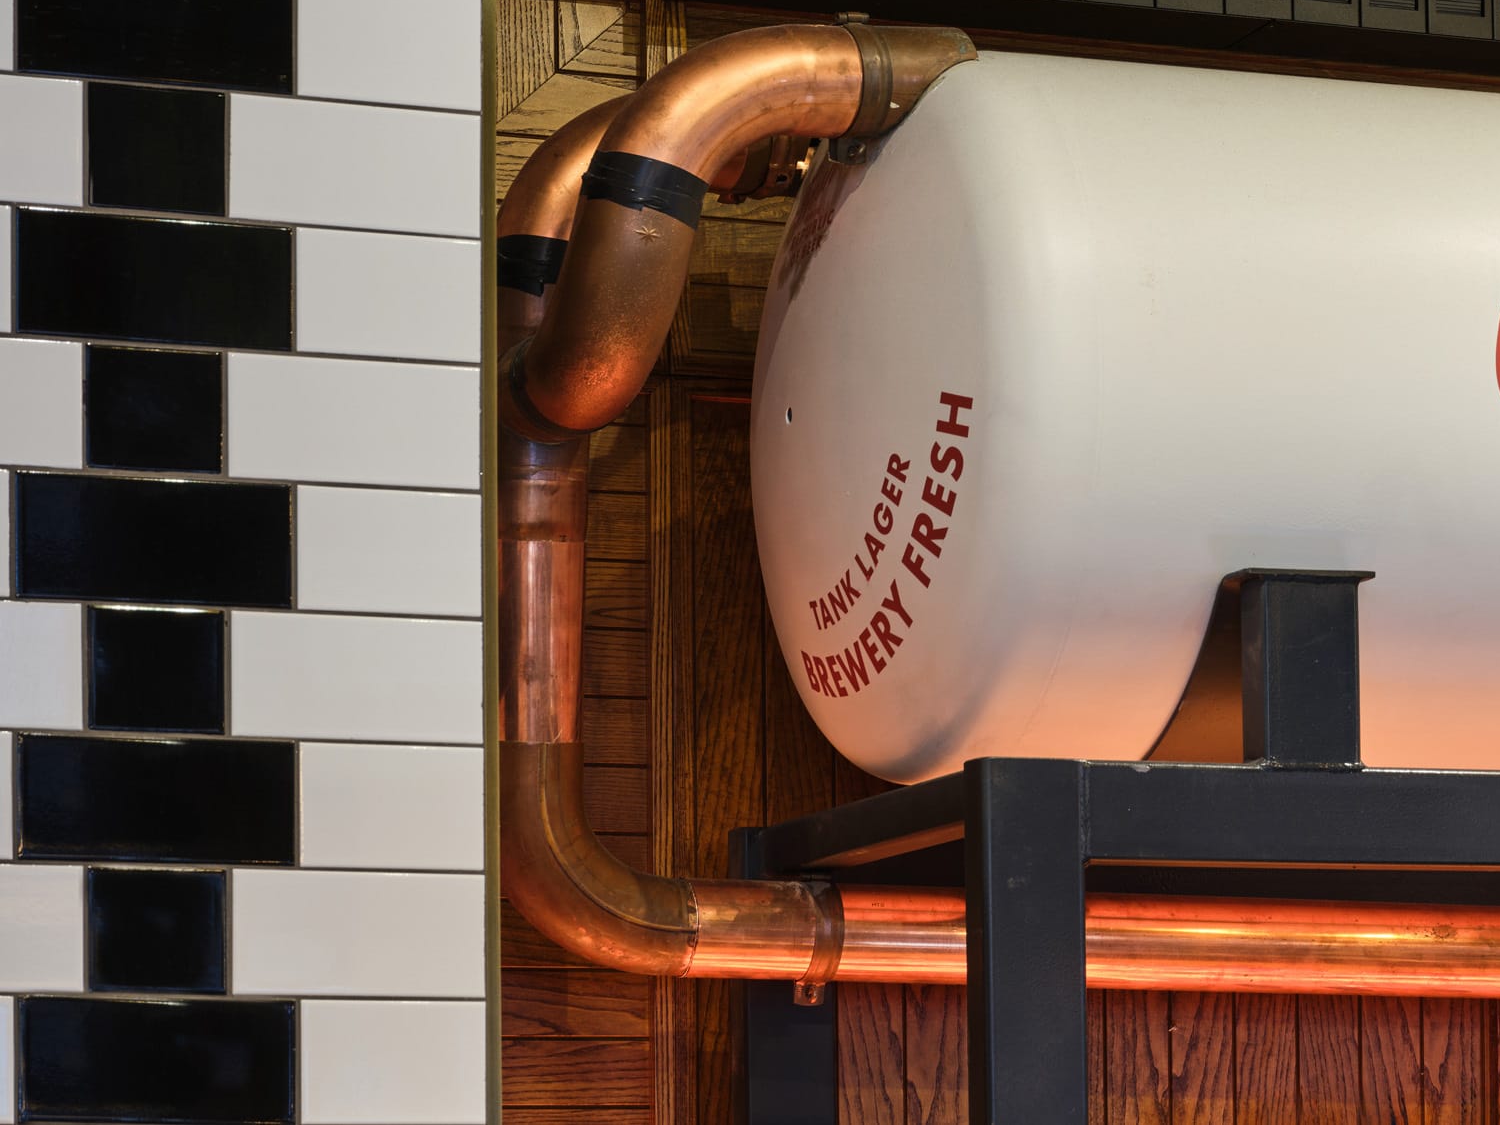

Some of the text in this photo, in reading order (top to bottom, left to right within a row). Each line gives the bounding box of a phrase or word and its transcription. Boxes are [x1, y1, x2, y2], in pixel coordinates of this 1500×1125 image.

[800, 391, 974, 699] BREWERY FRESH
[809, 452, 911, 631] TANK LAGER
